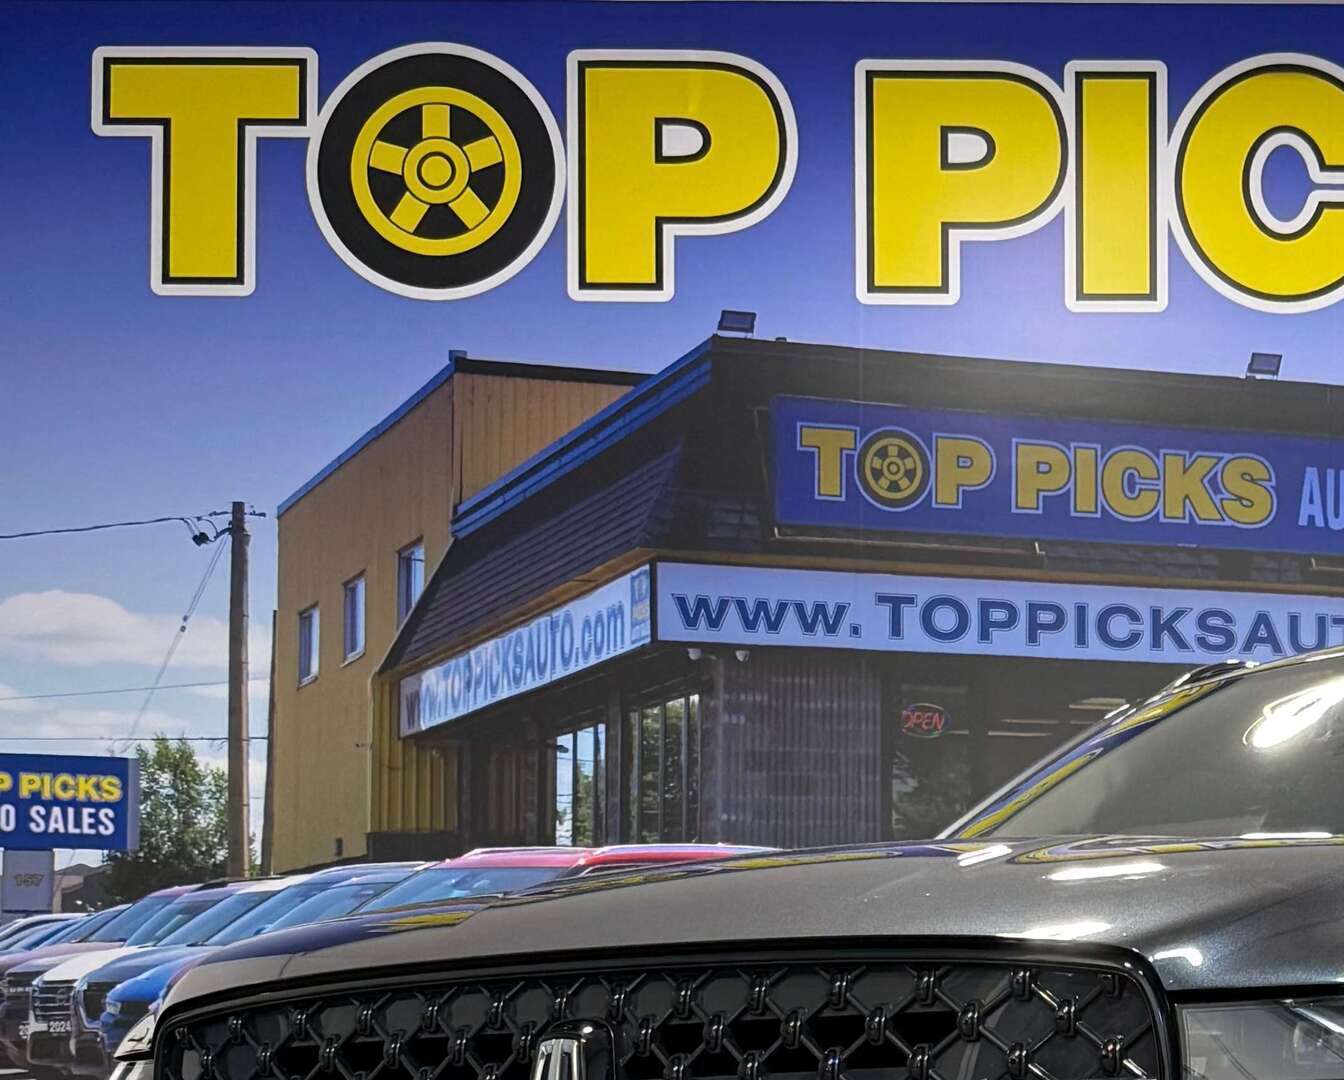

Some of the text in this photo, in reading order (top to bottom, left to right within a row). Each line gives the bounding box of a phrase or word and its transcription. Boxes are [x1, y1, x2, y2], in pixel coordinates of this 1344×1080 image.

[93, 42, 798, 303] TOP
[797, 421, 996, 512] TOP
[1011, 437, 1277, 529] PICKS
[901, 710, 945, 732] OPEN
[19, 772, 122, 801] PICKS
[29, 805, 115, 836] SALES
